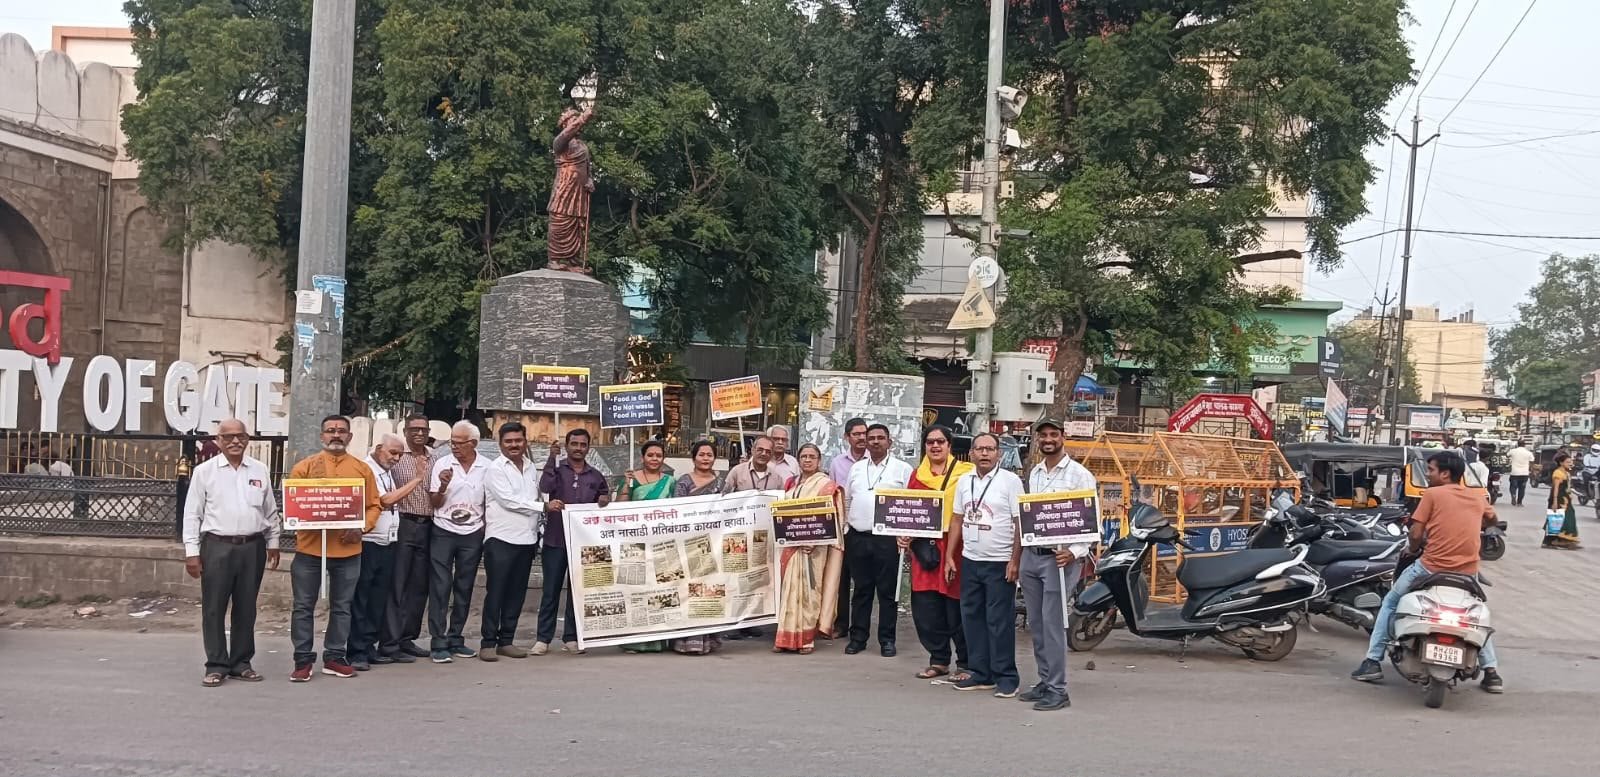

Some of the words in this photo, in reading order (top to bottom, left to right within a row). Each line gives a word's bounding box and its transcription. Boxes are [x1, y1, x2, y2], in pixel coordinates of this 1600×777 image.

[1325, 342, 1335, 360] P
[84, 354, 156, 432] OF
[583, 516, 599, 525] अन्न
[643, 509, 678, 521] समिती
[600, 529, 615, 539] अन्न
[618, 524, 648, 537] नासाडी
[652, 522, 690, 535] प्रतिबंधक
[694, 521, 721, 531] कायदा
[1227, 528, 1249, 540] HYOS
